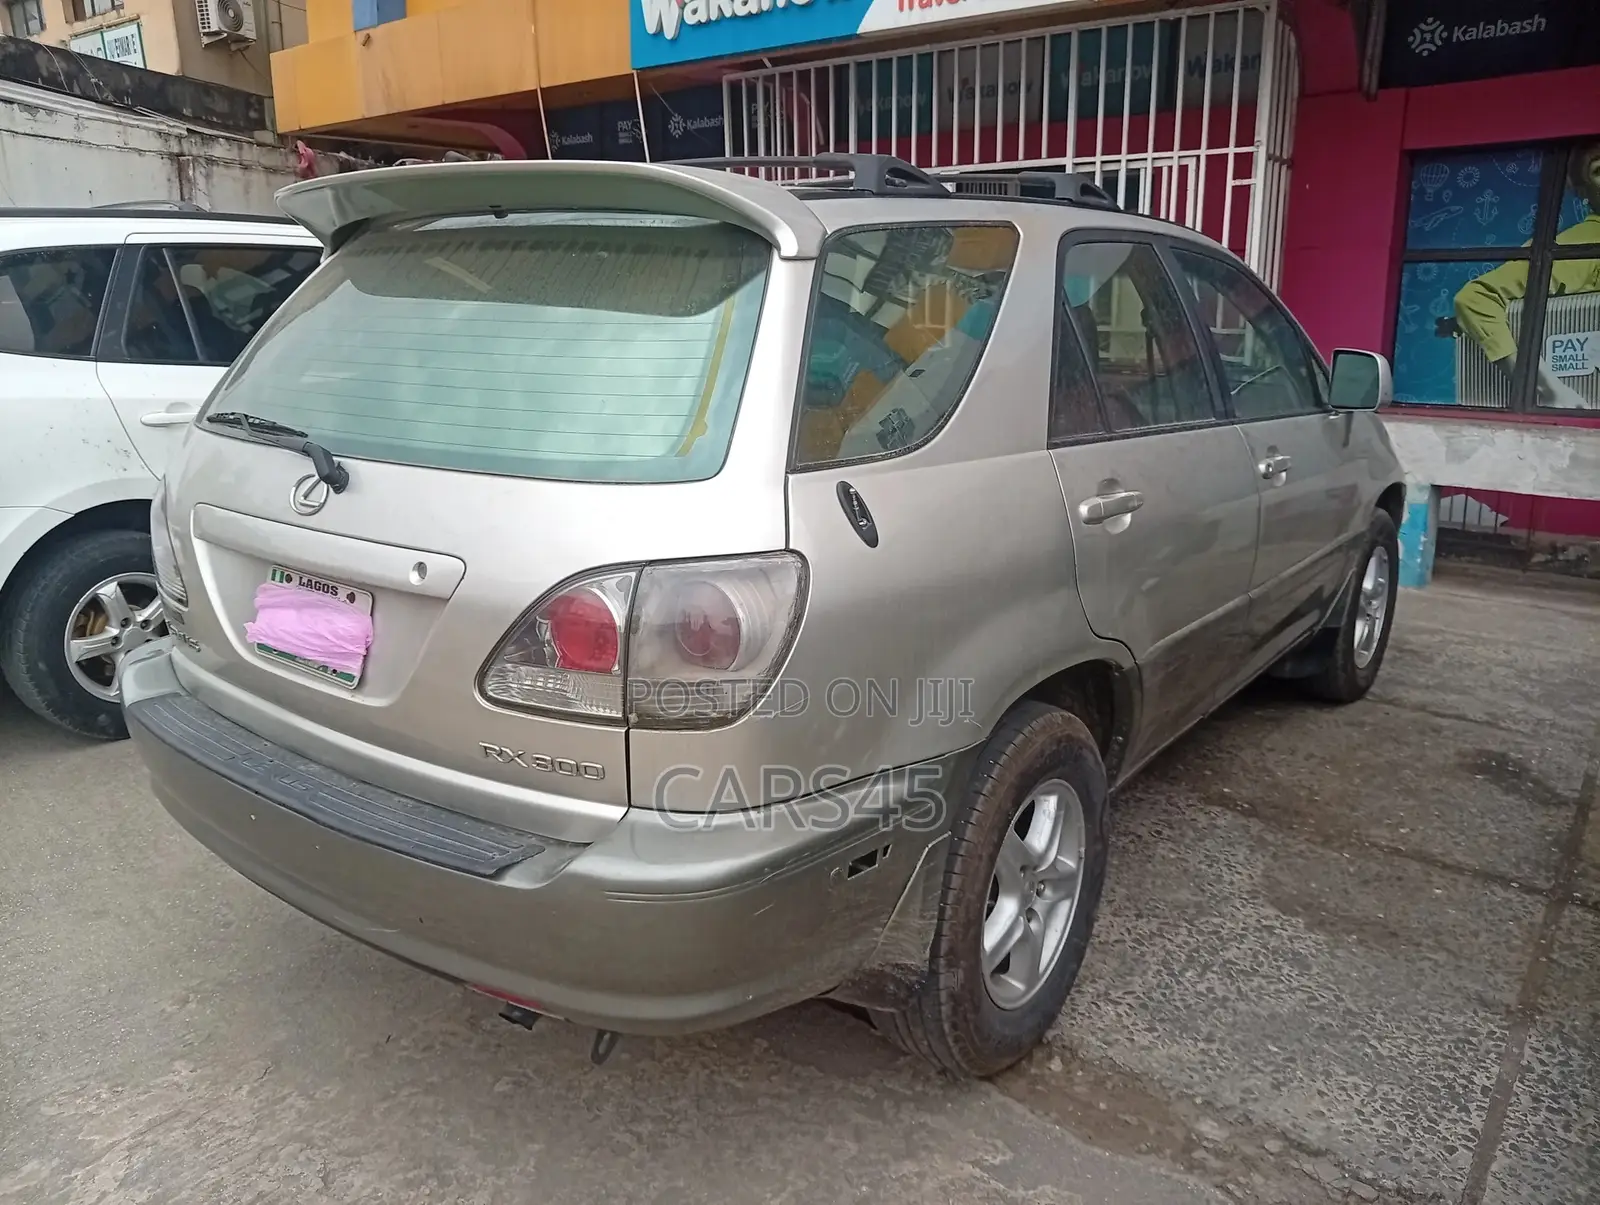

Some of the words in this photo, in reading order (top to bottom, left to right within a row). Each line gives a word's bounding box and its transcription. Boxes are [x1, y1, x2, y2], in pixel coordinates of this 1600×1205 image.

[1452, 13, 1547, 42] Kalabash
[1552, 337, 1589, 354] PAY
[1551, 353, 1589, 363] SMALL
[1551, 362, 1589, 372] SMALL
[298, 576, 339, 597] LAGOS
[479, 741, 529, 769] RX
[531, 753, 606, 781] 300
